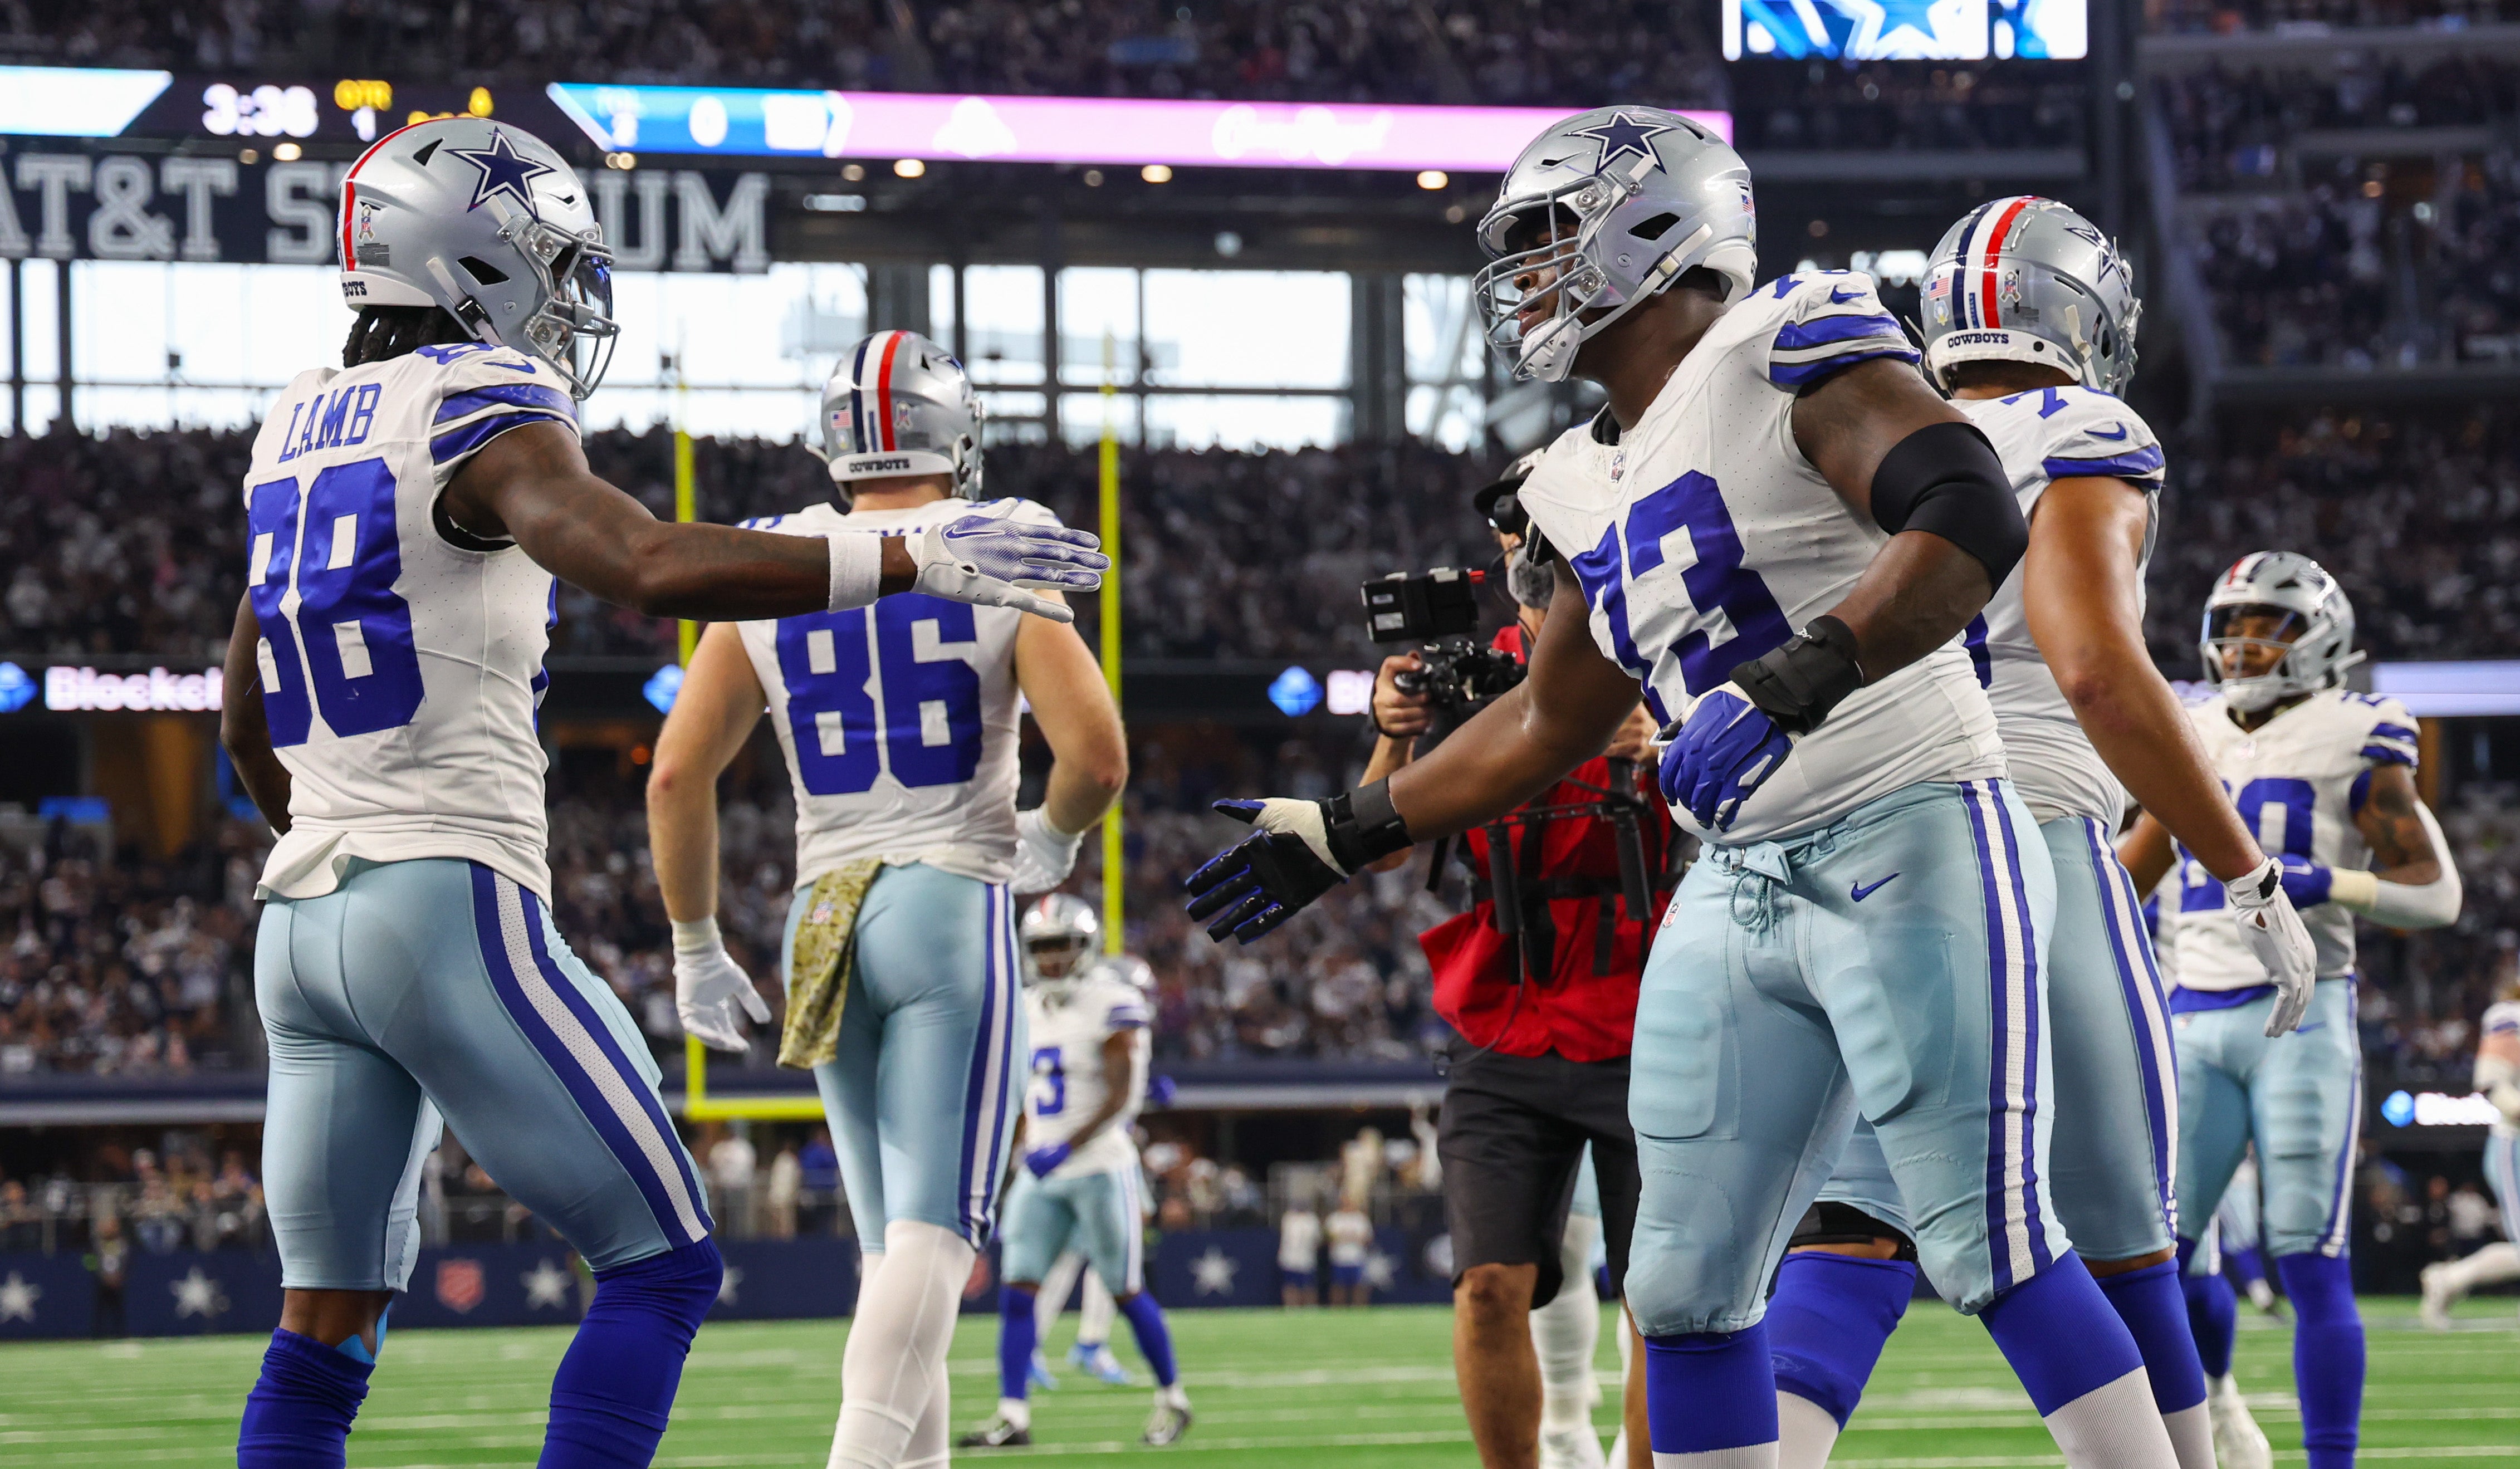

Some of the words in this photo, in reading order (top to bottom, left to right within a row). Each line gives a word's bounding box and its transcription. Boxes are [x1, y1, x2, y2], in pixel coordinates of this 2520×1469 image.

[342, 281, 368, 297] BOYS
[1948, 333, 2009, 348] COWBOYS
[279, 383, 381, 463] LAMB
[247, 457, 425, 749] 88
[1570, 469, 1794, 726] 73
[776, 592, 983, 795] 86
[1029, 1047, 1064, 1115] 3
